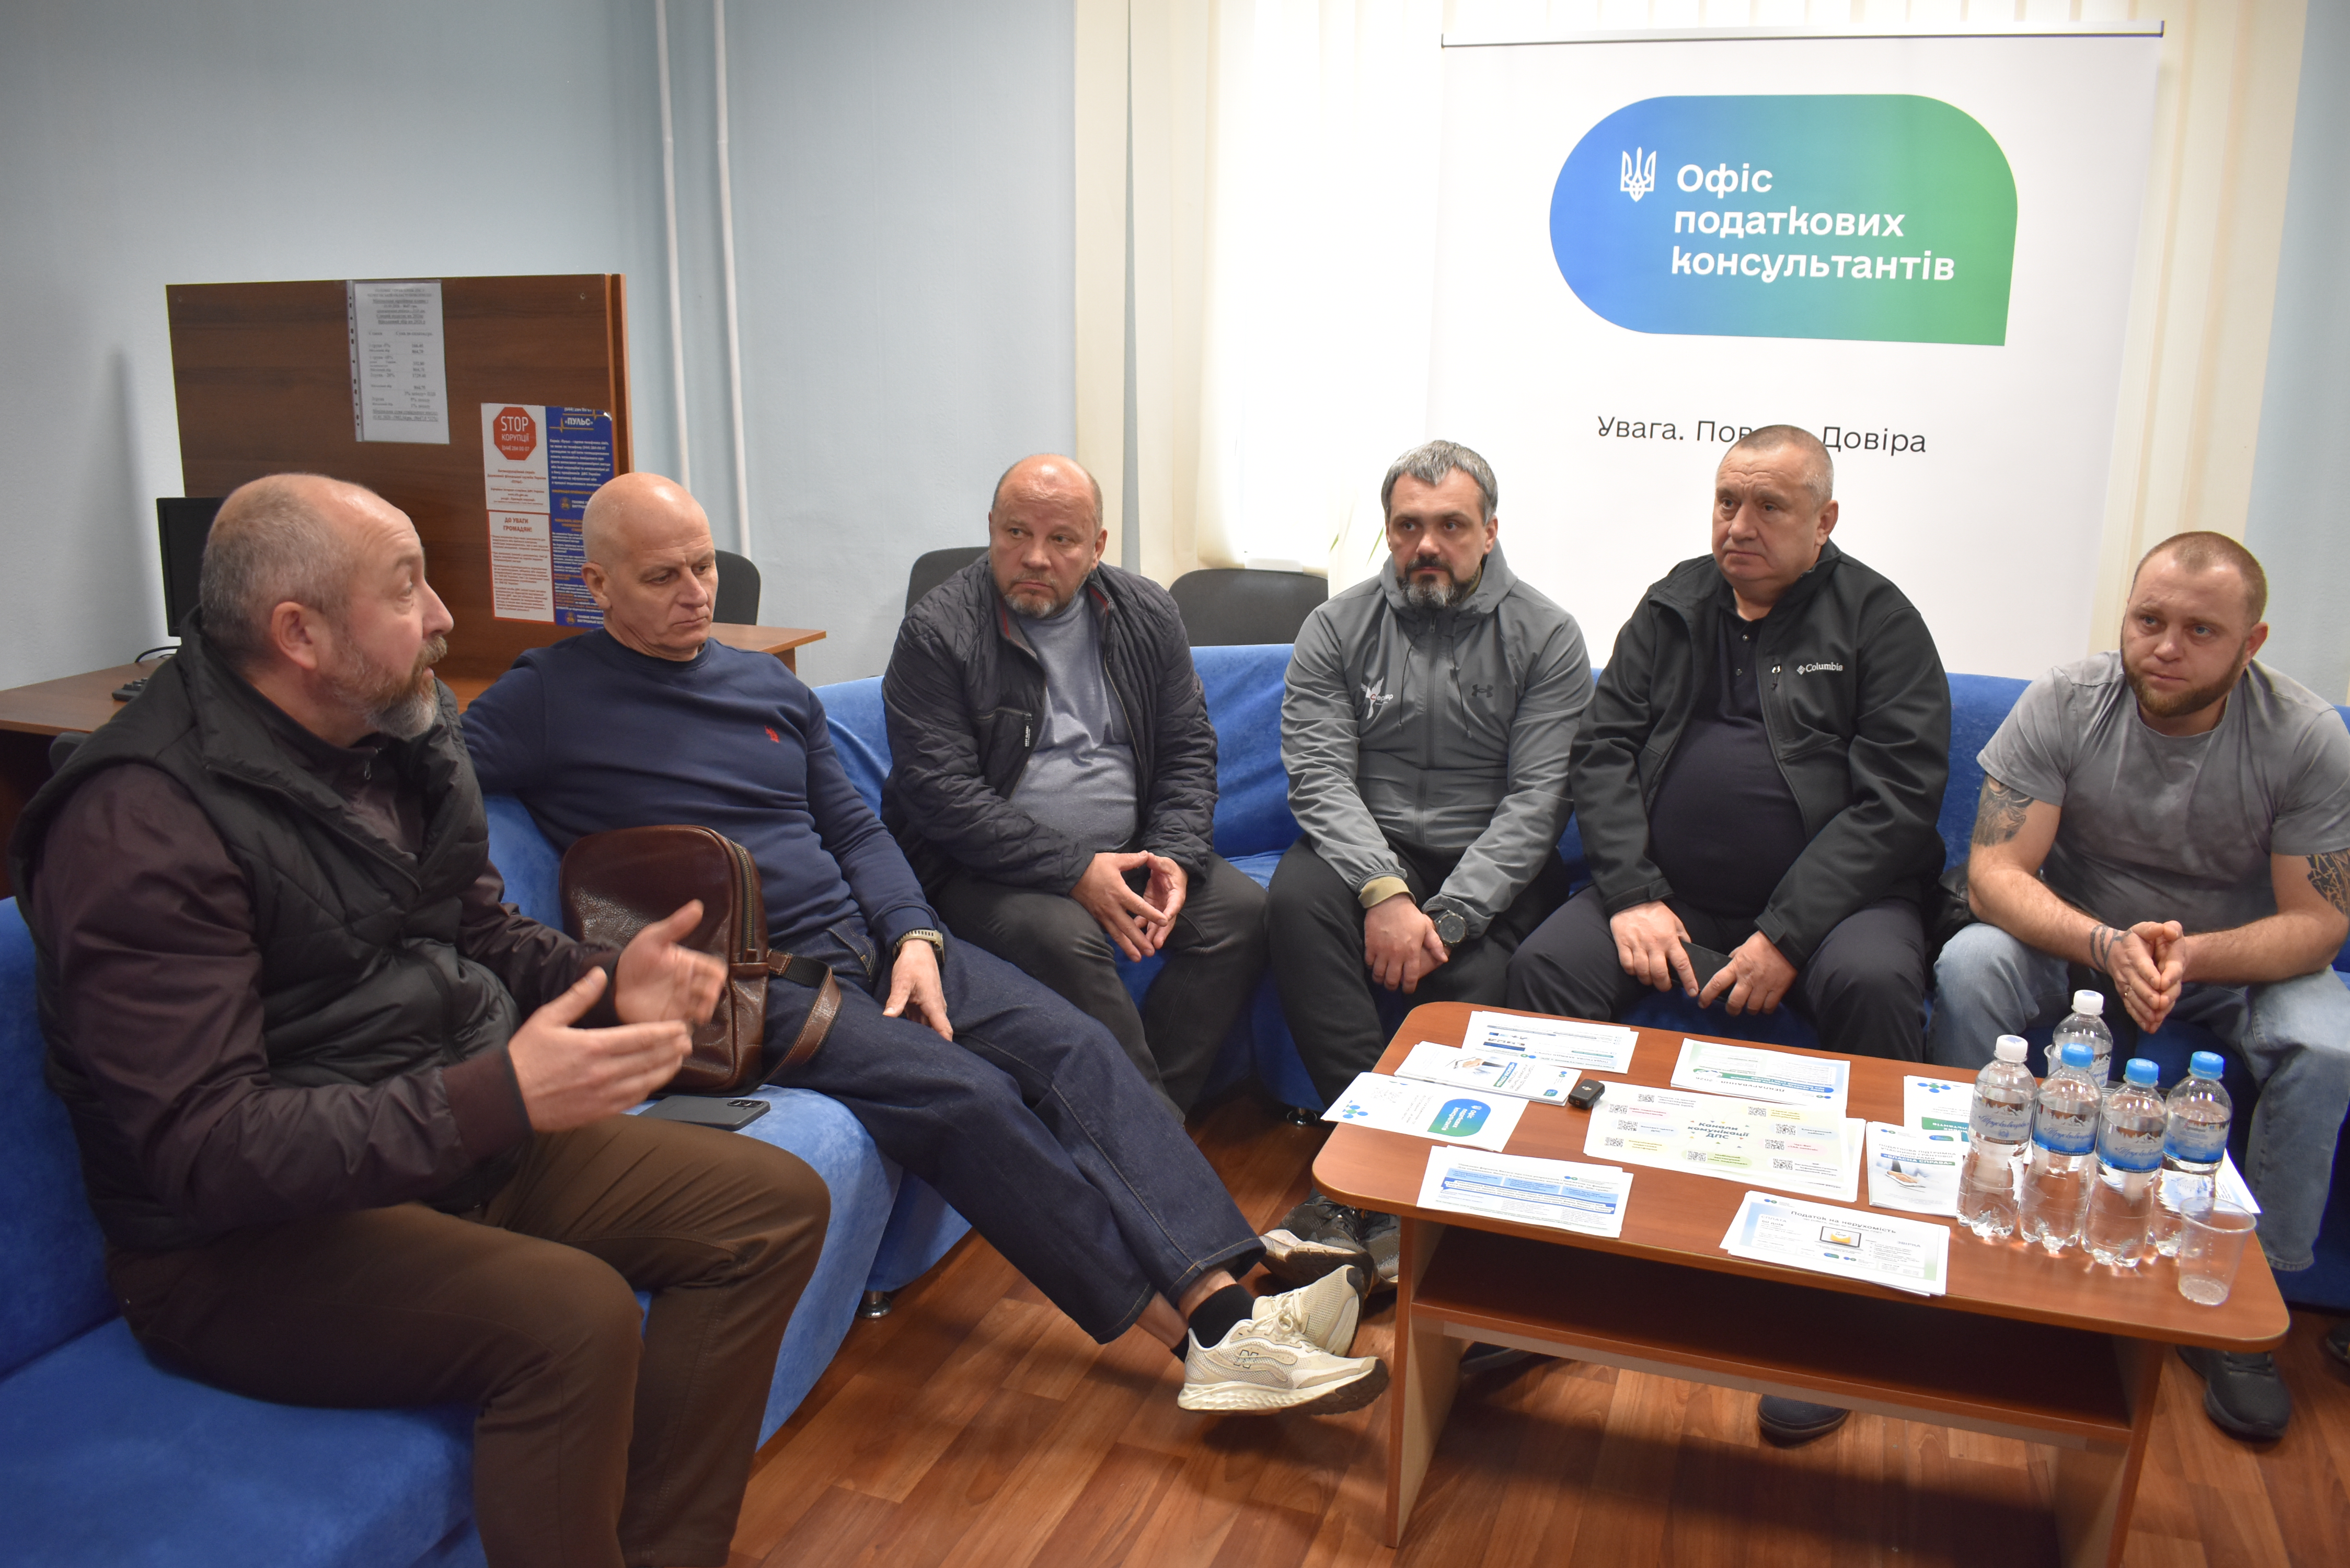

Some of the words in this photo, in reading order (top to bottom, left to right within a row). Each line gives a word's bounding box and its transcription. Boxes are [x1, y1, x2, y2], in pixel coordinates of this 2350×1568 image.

[1677, 163, 1773, 199] Офіс
[1674, 206, 1906, 239] податкових
[1672, 246, 1955, 283] консультантів
[501, 416, 528, 432] STOP
[565, 417, 593, 426] «ПУЛЬС»
[501, 433, 529, 443] КОРУПЦІЇ
[1598, 416, 1684, 440] Увага.
[1696, 420, 1754, 443] Пов
[1823, 426, 1926, 456] Довіра
[1805, 662, 1843, 672] Columbia
[1465, 1109, 1477, 1119] Офіс
[1687, 1125, 1749, 1137] комунікації
[1698, 1122, 1738, 1131] Канали
[1879, 1144, 1916, 1152] ПОДАТКОВА
[1881, 1147, 1916, 1155] УЧАСНИКІВ
[1883, 1154, 1917, 1162] «ВЛАСНА
[1790, 1210, 1827, 1221] Податок
[1841, 1220, 1896, 1234] нерухомість
